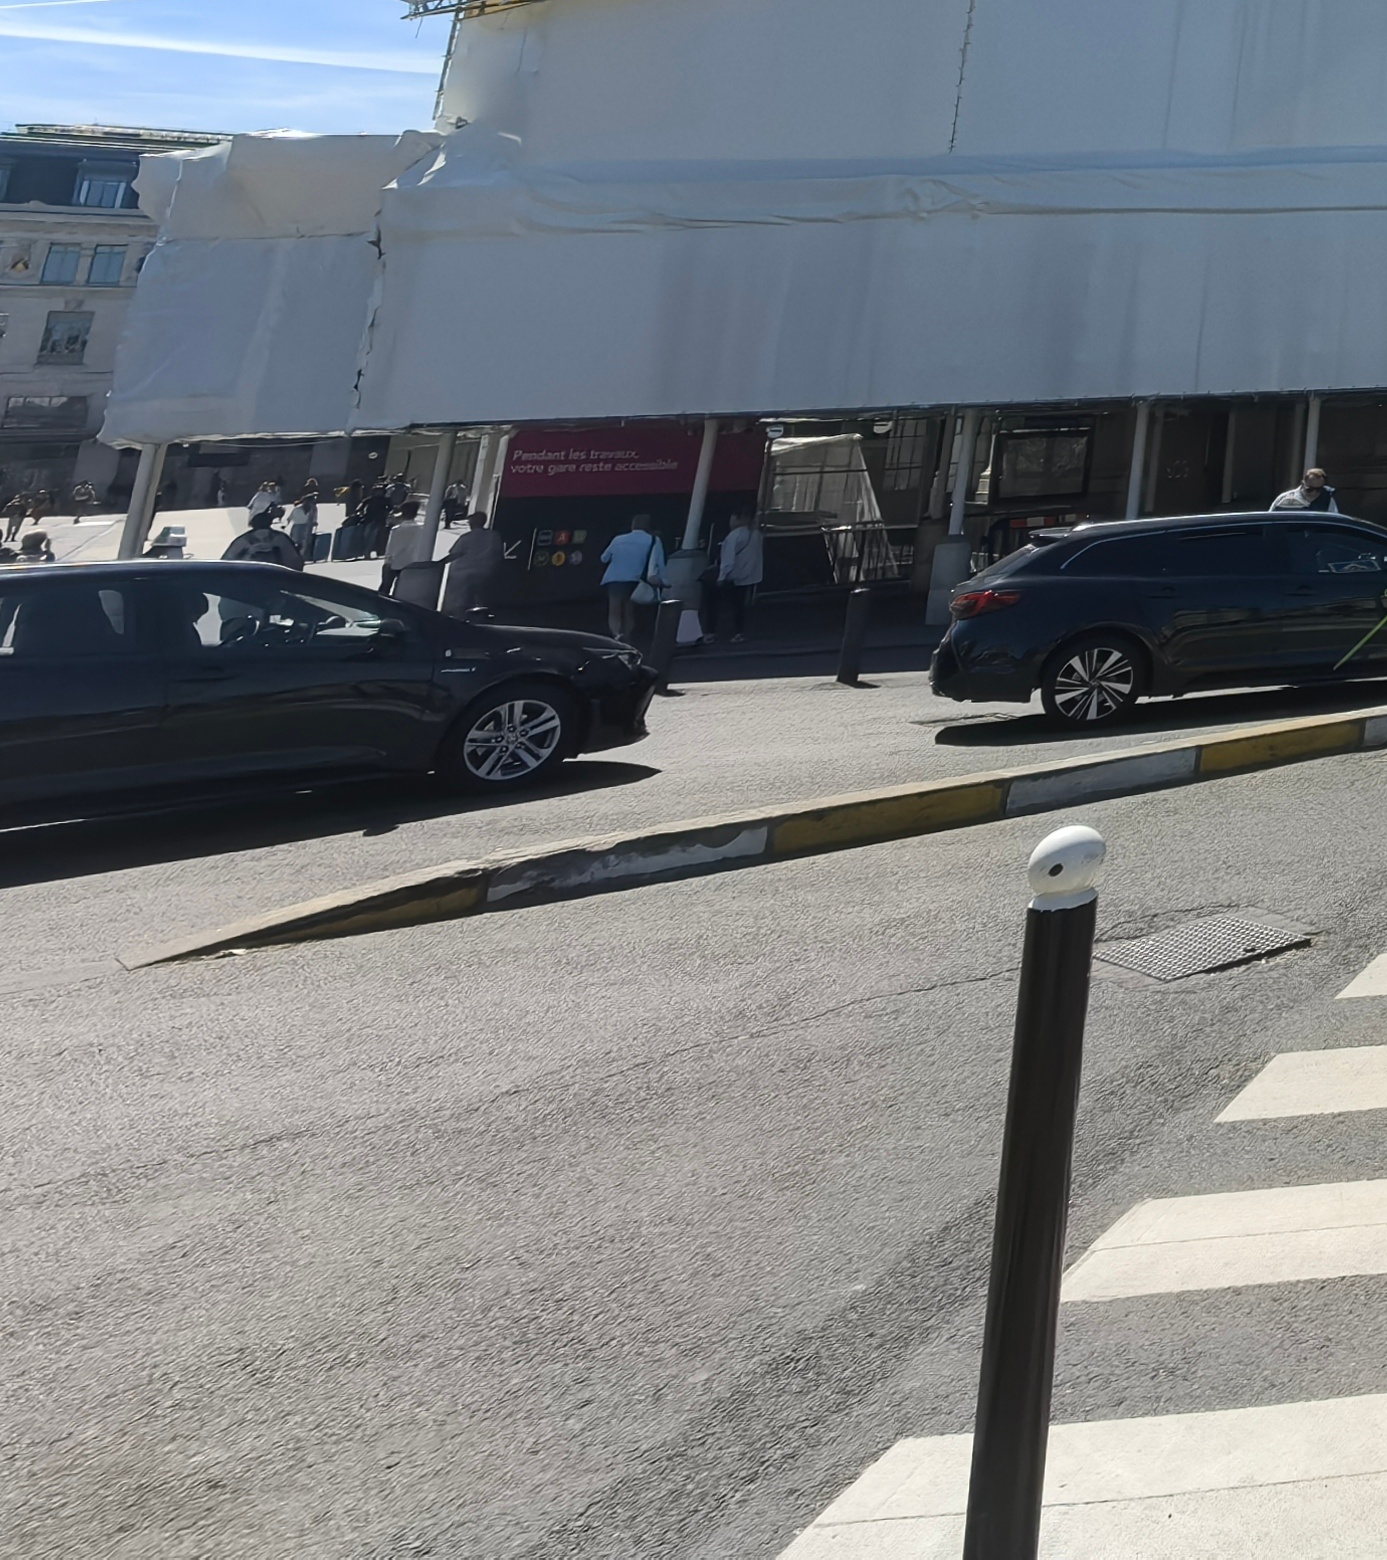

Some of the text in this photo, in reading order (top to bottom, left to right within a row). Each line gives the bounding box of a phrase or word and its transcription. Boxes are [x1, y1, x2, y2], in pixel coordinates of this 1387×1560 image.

[512, 449, 565, 461] Pendant
[568, 448, 587, 460] les
[511, 464, 544, 474] votre
[547, 464, 577, 476] gare
[579, 462, 612, 473] reste
